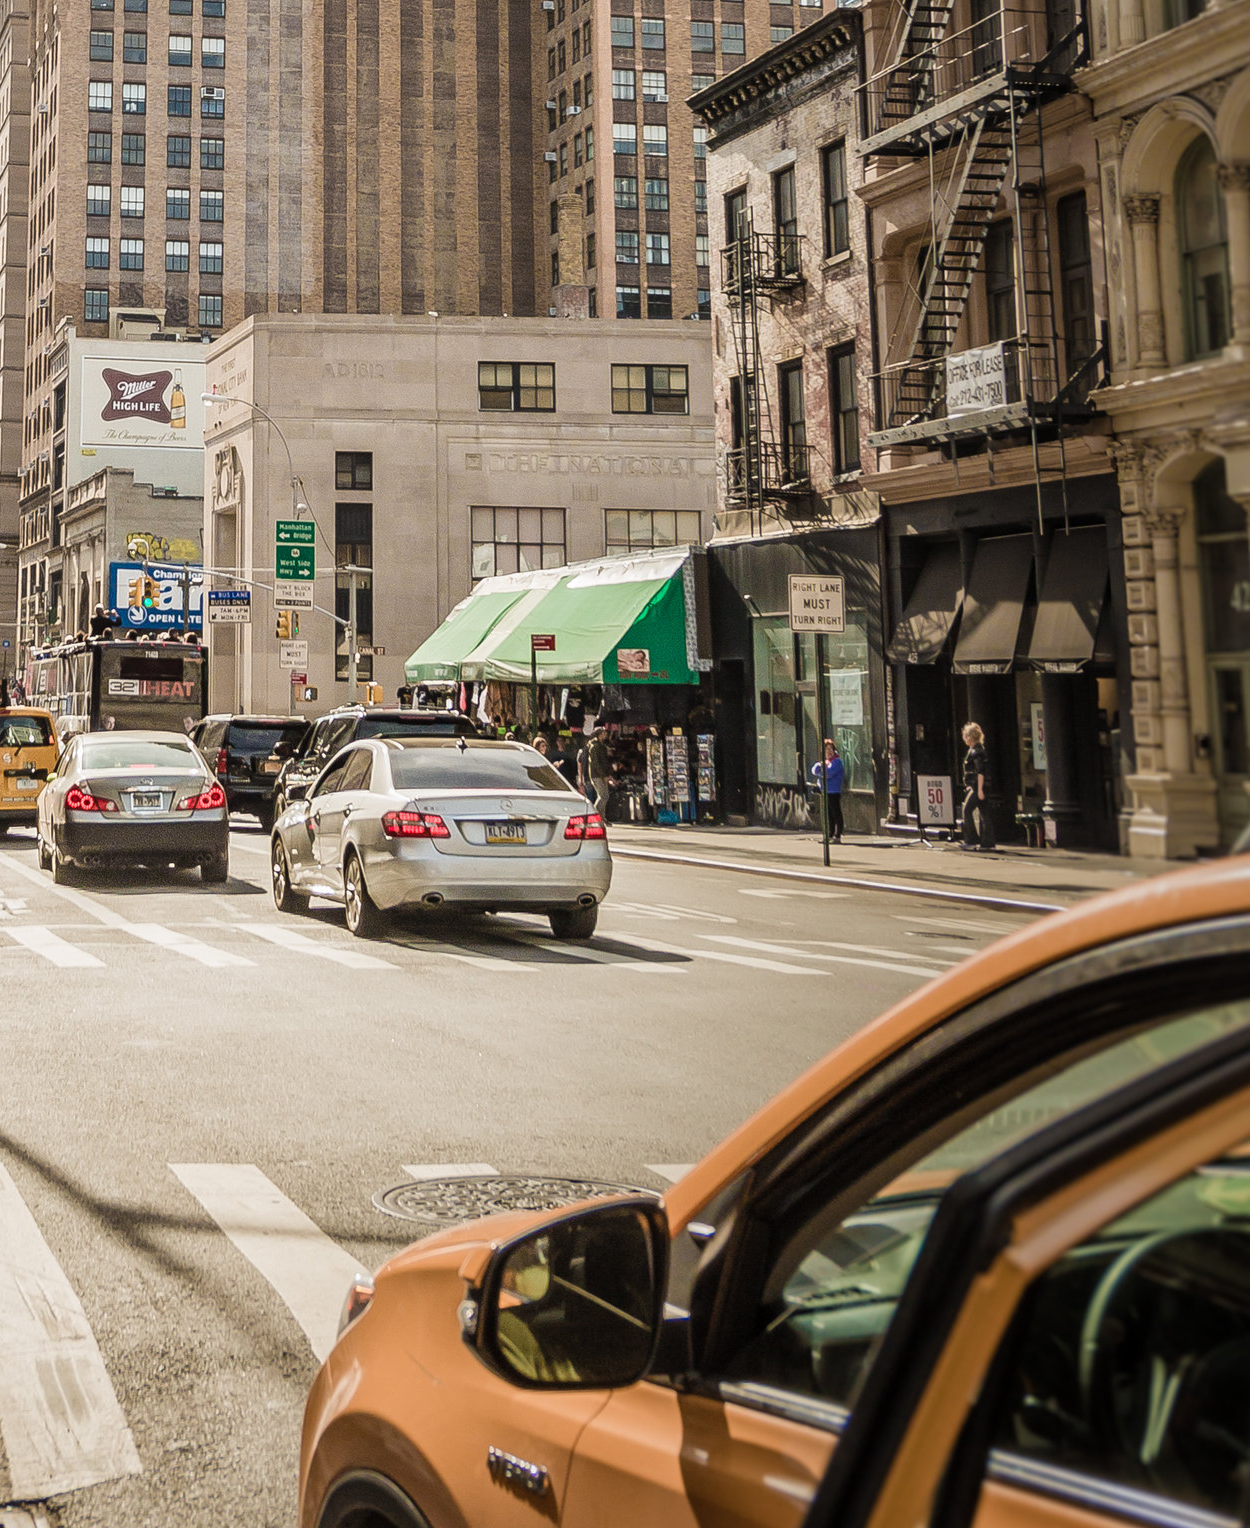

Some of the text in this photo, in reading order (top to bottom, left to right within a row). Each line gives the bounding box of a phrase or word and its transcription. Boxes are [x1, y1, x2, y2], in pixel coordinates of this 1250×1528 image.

[982, 354, 1002, 375] LEASE
[117, 380, 157, 399] Miller
[112, 400, 161, 411] HIGH LIFE
[118, 429, 158, 444] Champagne
[293, 532, 312, 541] Bridge
[792, 583, 841, 593] RIGHT LANE
[803, 598, 830, 610] MUST
[148, 614, 174, 623] OPEN
[793, 615, 841, 625] TURN RIGHT
[147, 681, 195, 697] HEAT
[927, 788, 944, 804] 50
